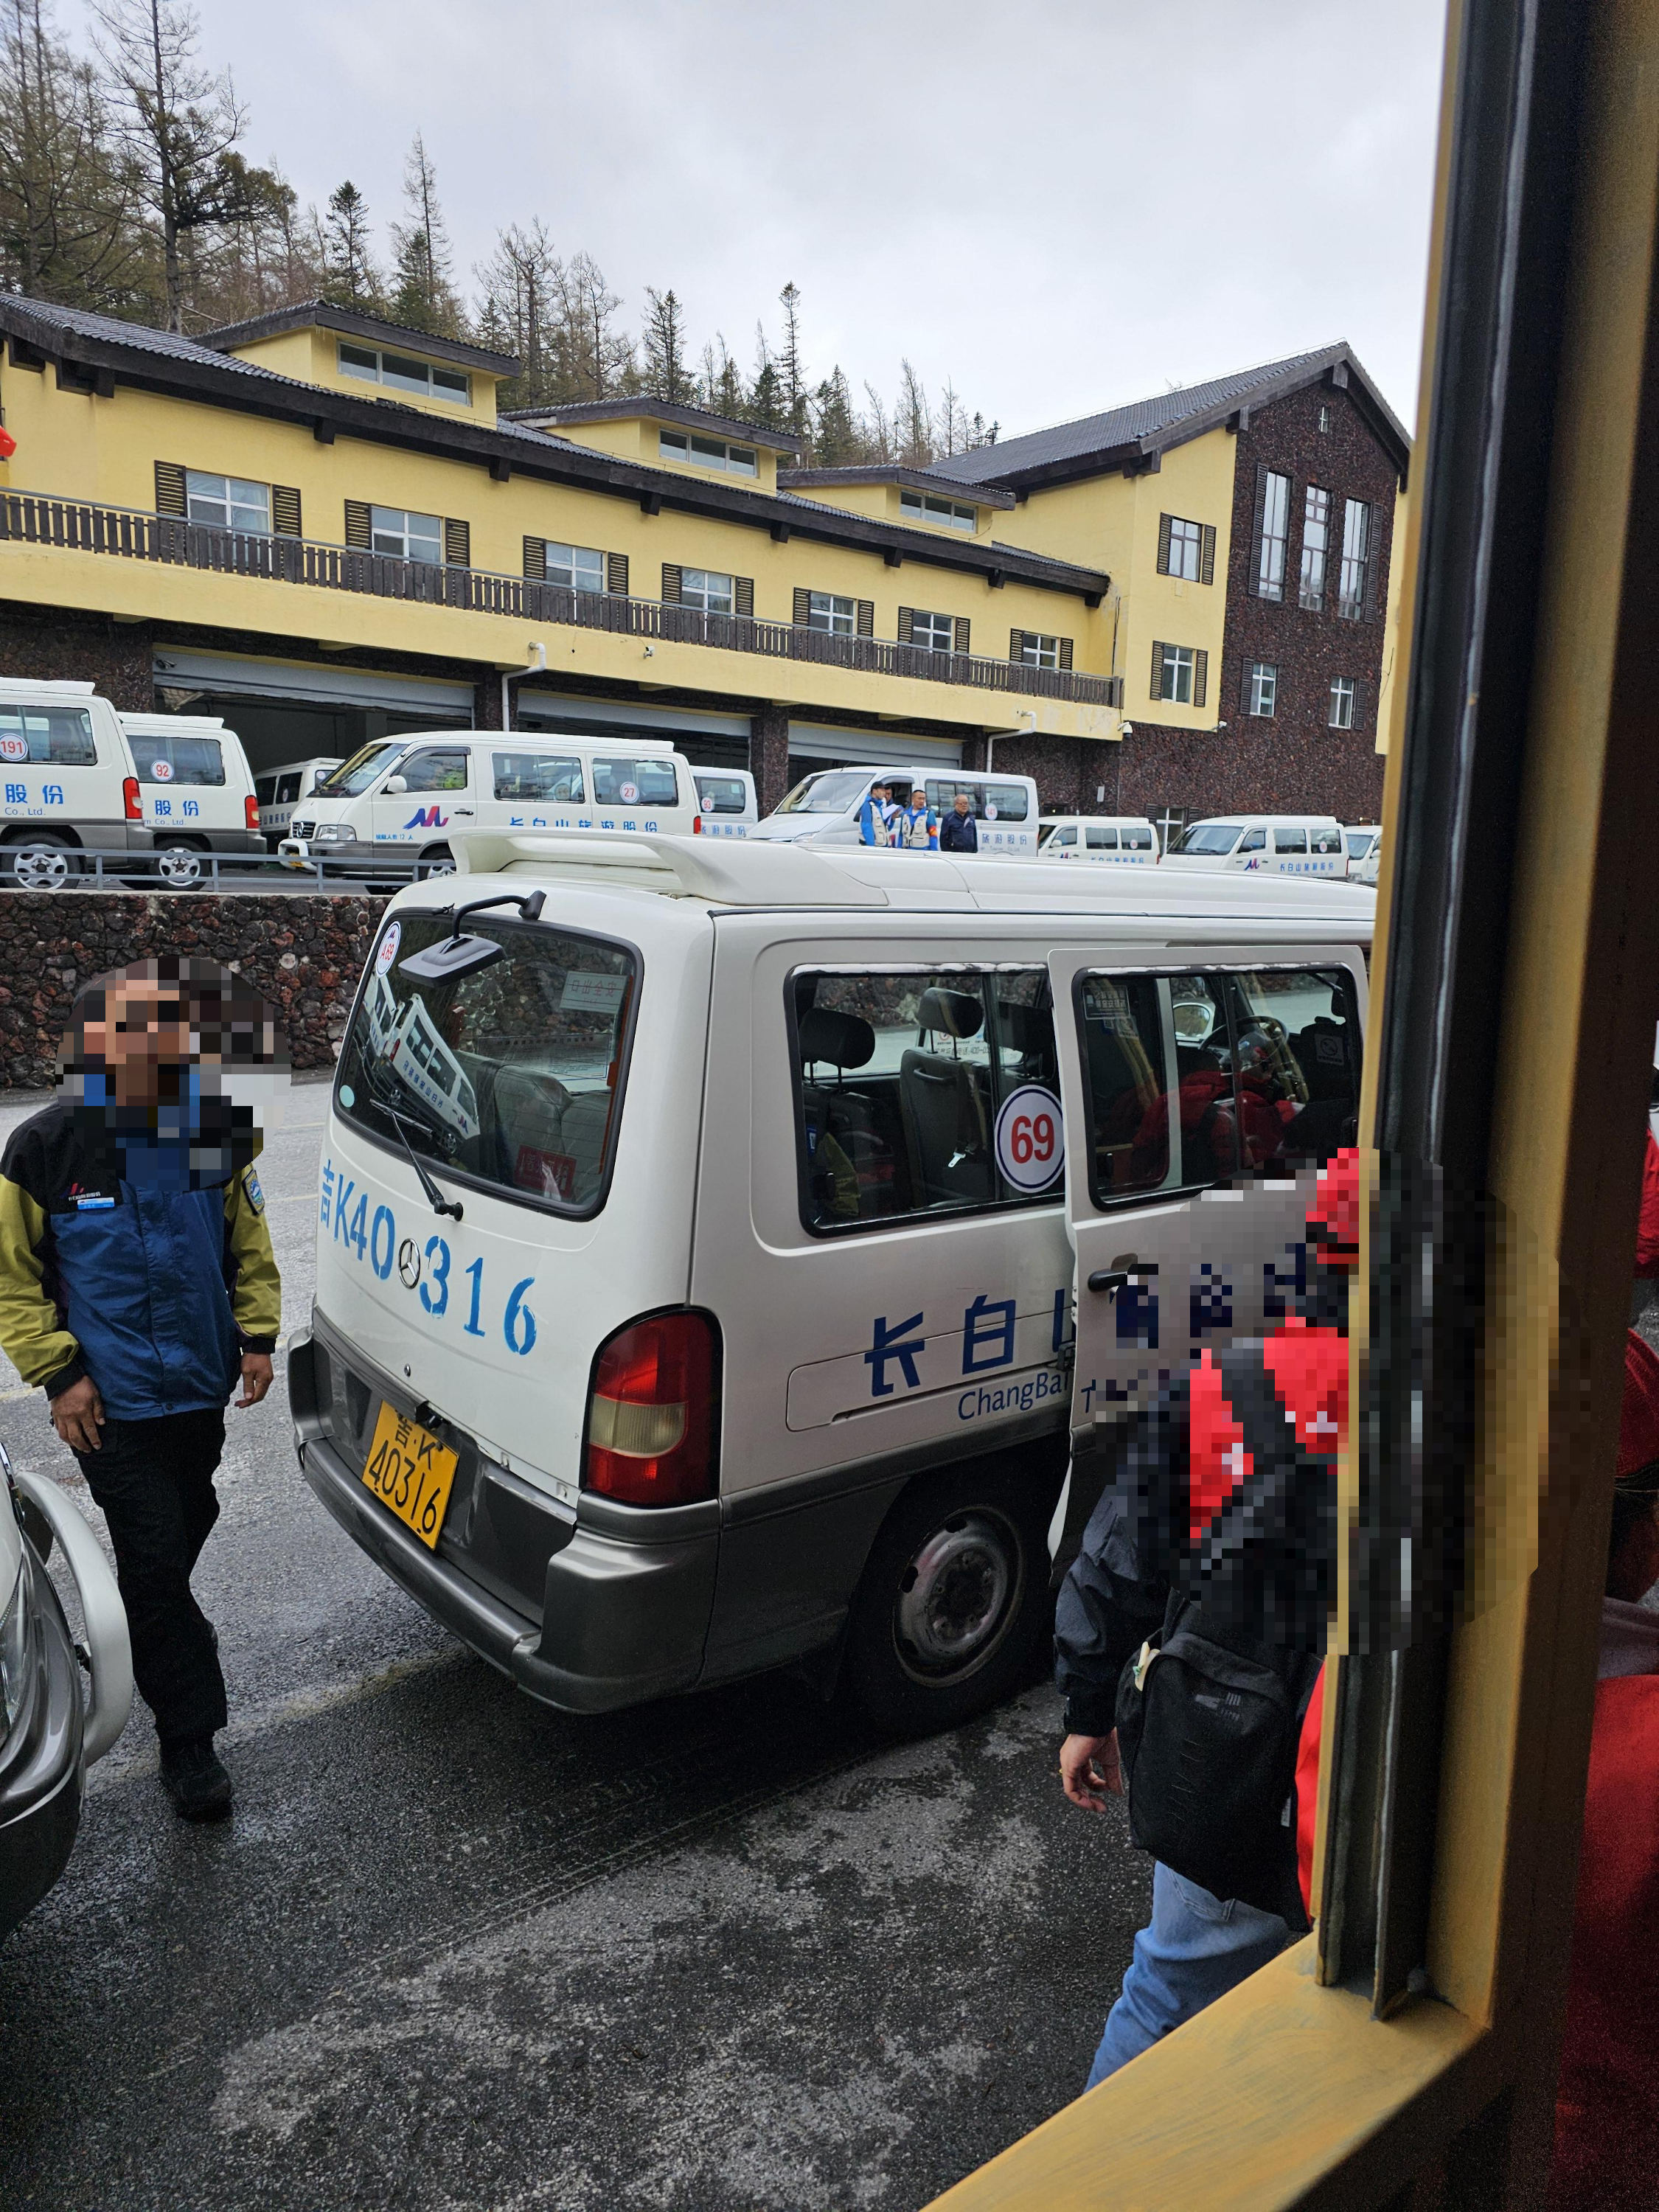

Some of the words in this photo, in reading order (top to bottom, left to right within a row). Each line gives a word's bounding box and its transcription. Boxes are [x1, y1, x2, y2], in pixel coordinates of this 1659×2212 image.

[0, 740, 23, 754] 191
[156, 764, 170, 776] 92
[5, 784, 64, 804] 股份
[624, 787, 634, 797] 27
[142, 800, 198, 816] 股份
[1011, 1113, 1054, 1164] 69
[369, 1439, 441, 1534] 40316
